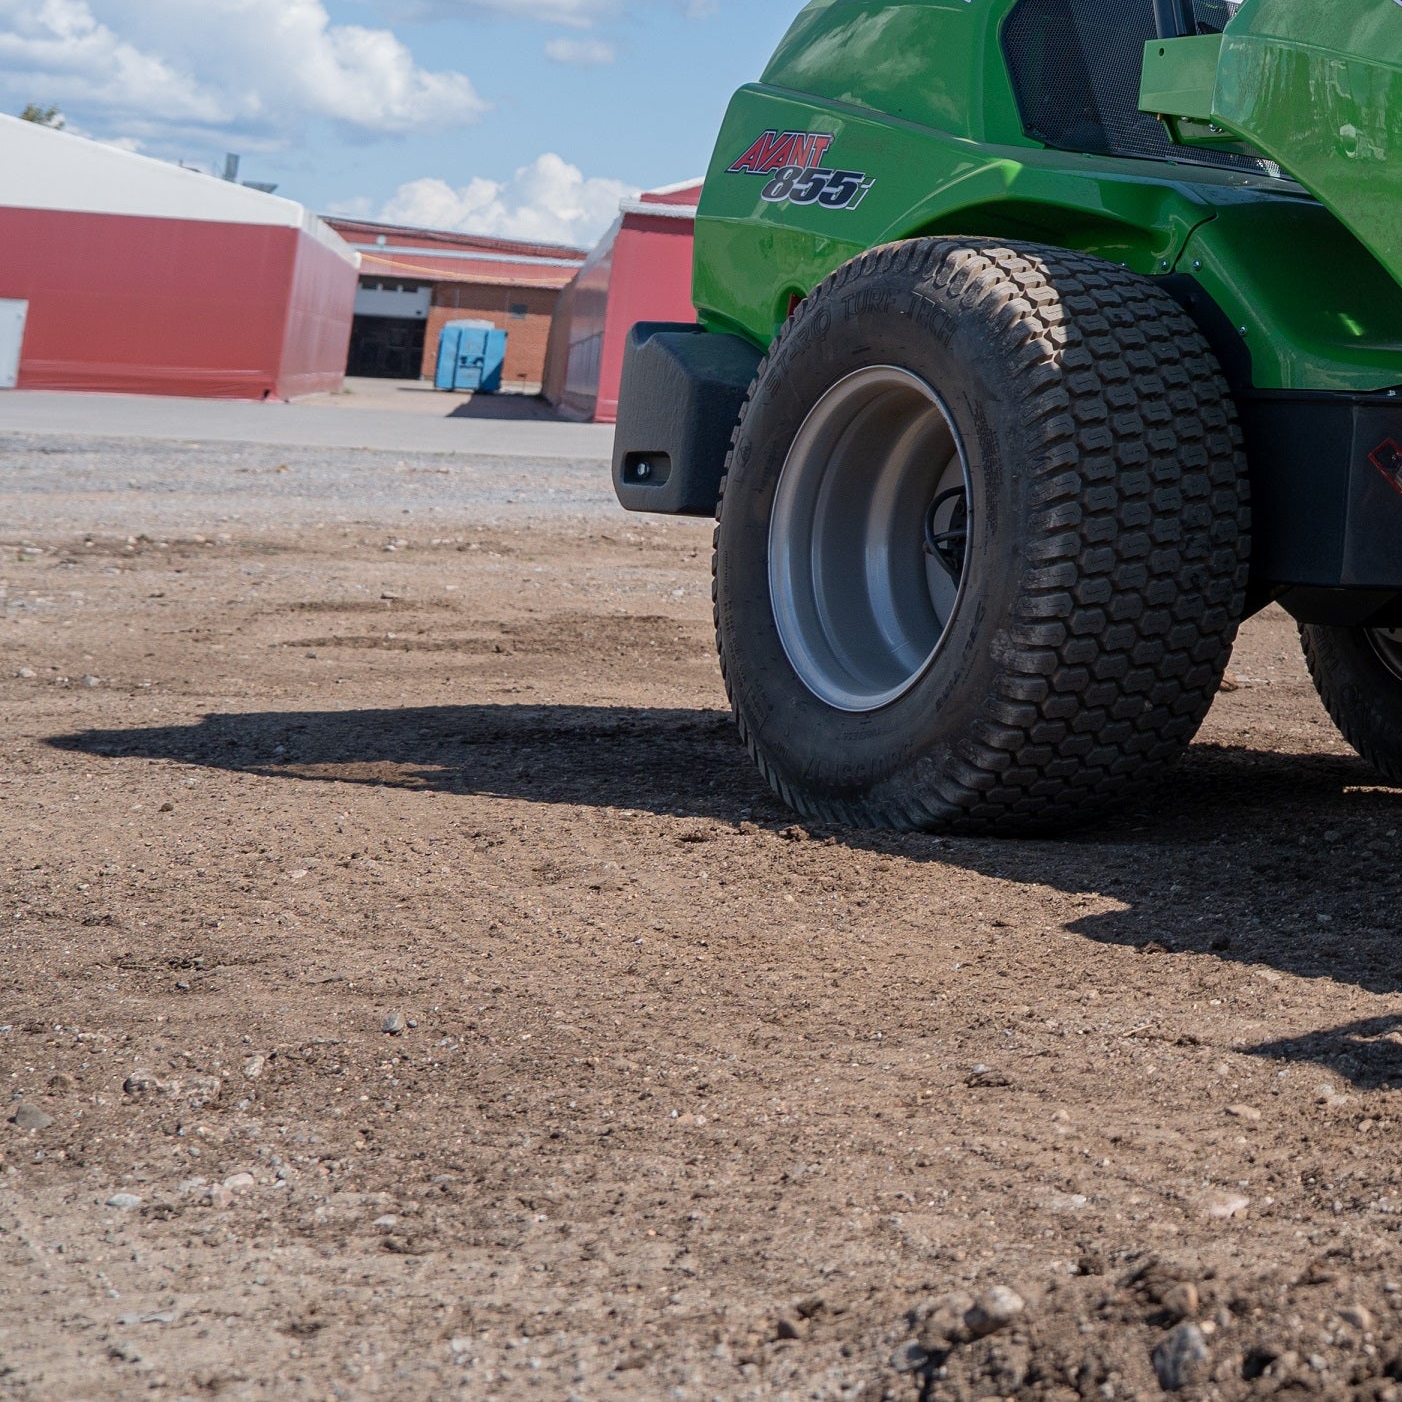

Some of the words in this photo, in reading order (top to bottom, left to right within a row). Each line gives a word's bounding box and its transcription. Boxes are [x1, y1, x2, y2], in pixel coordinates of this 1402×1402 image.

[724, 129, 835, 175] AVANT
[760, 165, 877, 210] 855i
[841, 287, 896, 321] TURF
[905, 292, 960, 350] TECH
